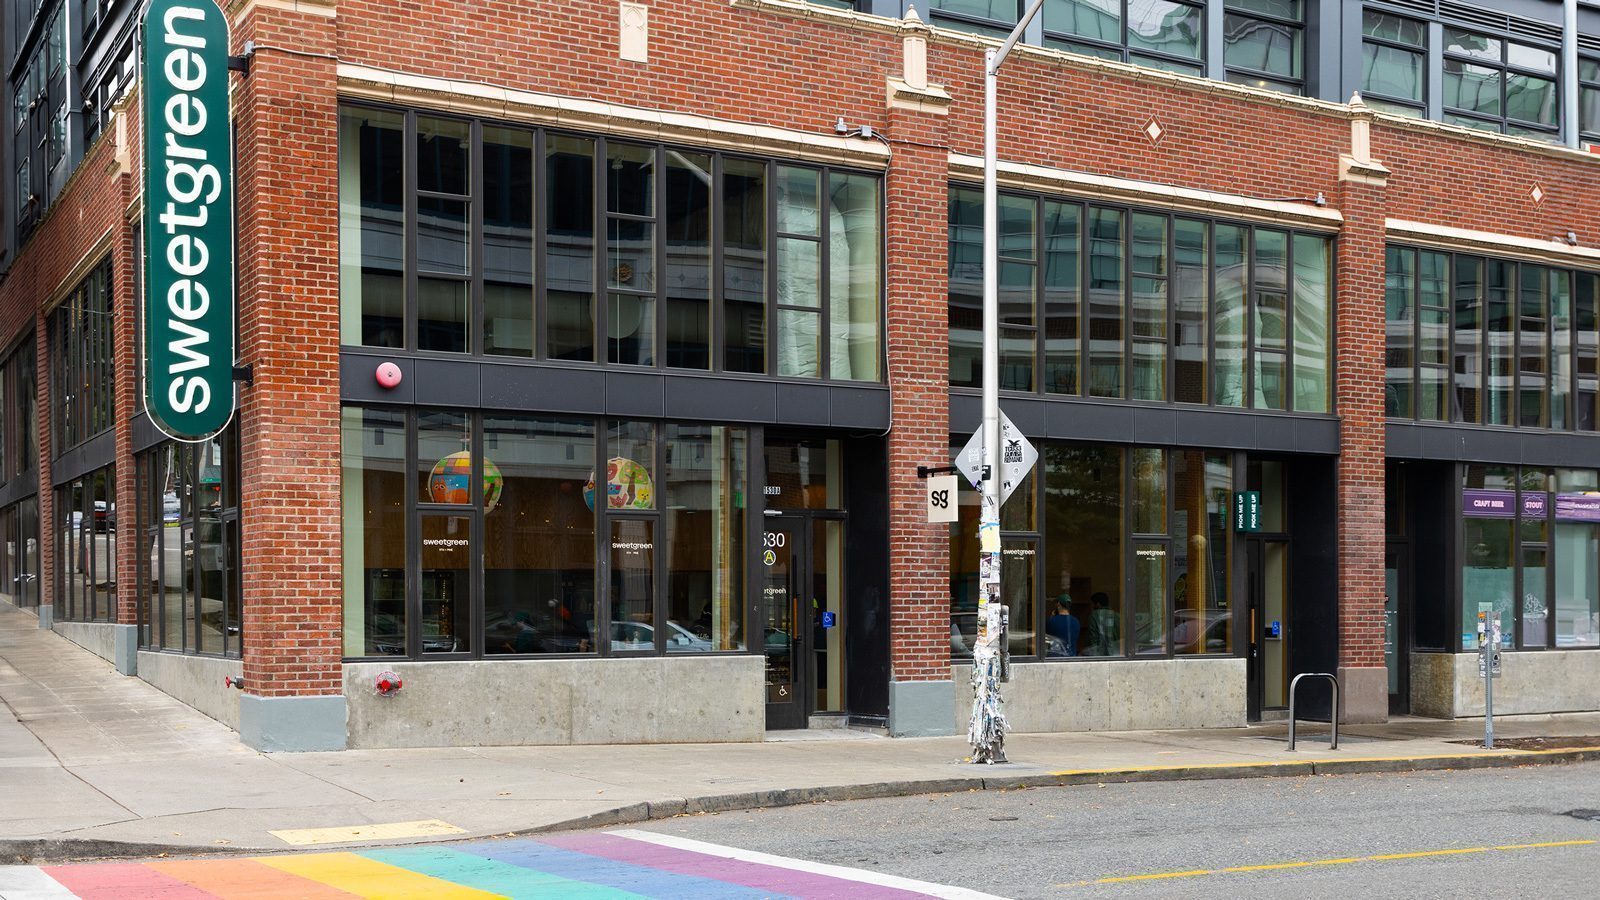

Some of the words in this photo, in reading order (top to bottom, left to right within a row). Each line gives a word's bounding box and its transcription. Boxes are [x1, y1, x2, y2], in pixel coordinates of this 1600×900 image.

[159, 4, 222, 415] sweetgreen
[931, 489, 949, 509] sg
[1238, 494, 1244, 504] UP
[1250, 493, 1257, 504] UP
[1238, 503, 1244, 513] ME
[1250, 503, 1257, 513] ME
[1473, 500, 1491, 508] CRAFT
[1525, 501, 1543, 509] STOUT
[423, 539, 469, 547] sweetgreen
[612, 542, 653, 550] sweetgreen
